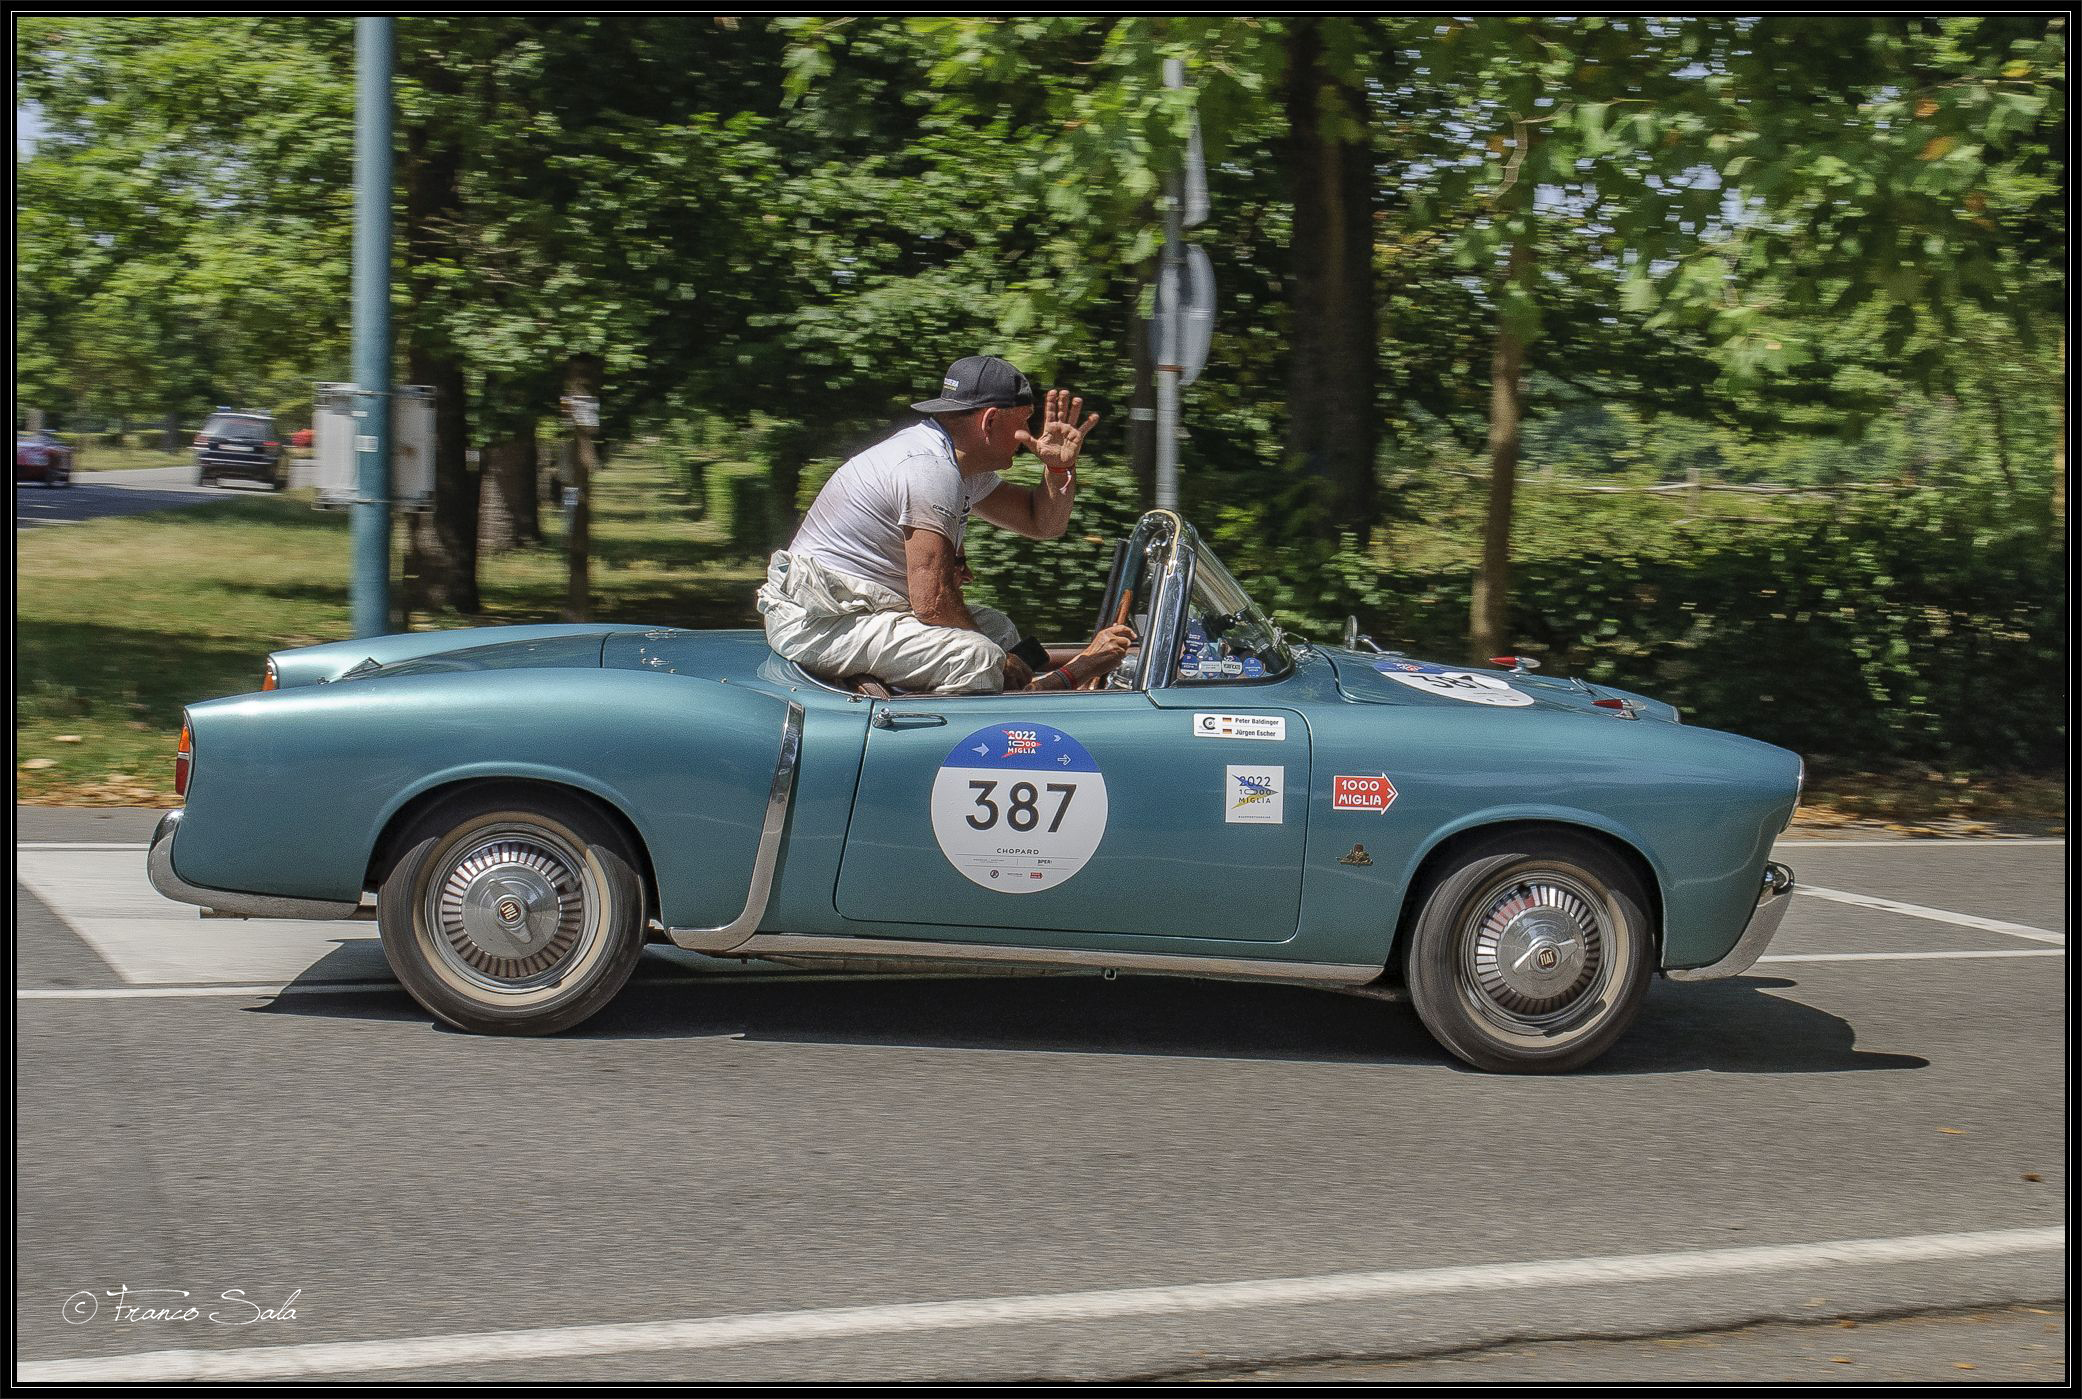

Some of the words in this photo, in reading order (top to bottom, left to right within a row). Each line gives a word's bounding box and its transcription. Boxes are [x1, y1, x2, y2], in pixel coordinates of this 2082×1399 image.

[1252, 718, 1279, 726] Baldinger
[1008, 731, 1036, 740] 2022
[1239, 776, 1271, 786] 2022
[1341, 780, 1379, 791] 1000
[1338, 794, 1382, 805] MIGLIA
[965, 780, 1077, 833] 387
[1540, 951, 1554, 966] FIAT
